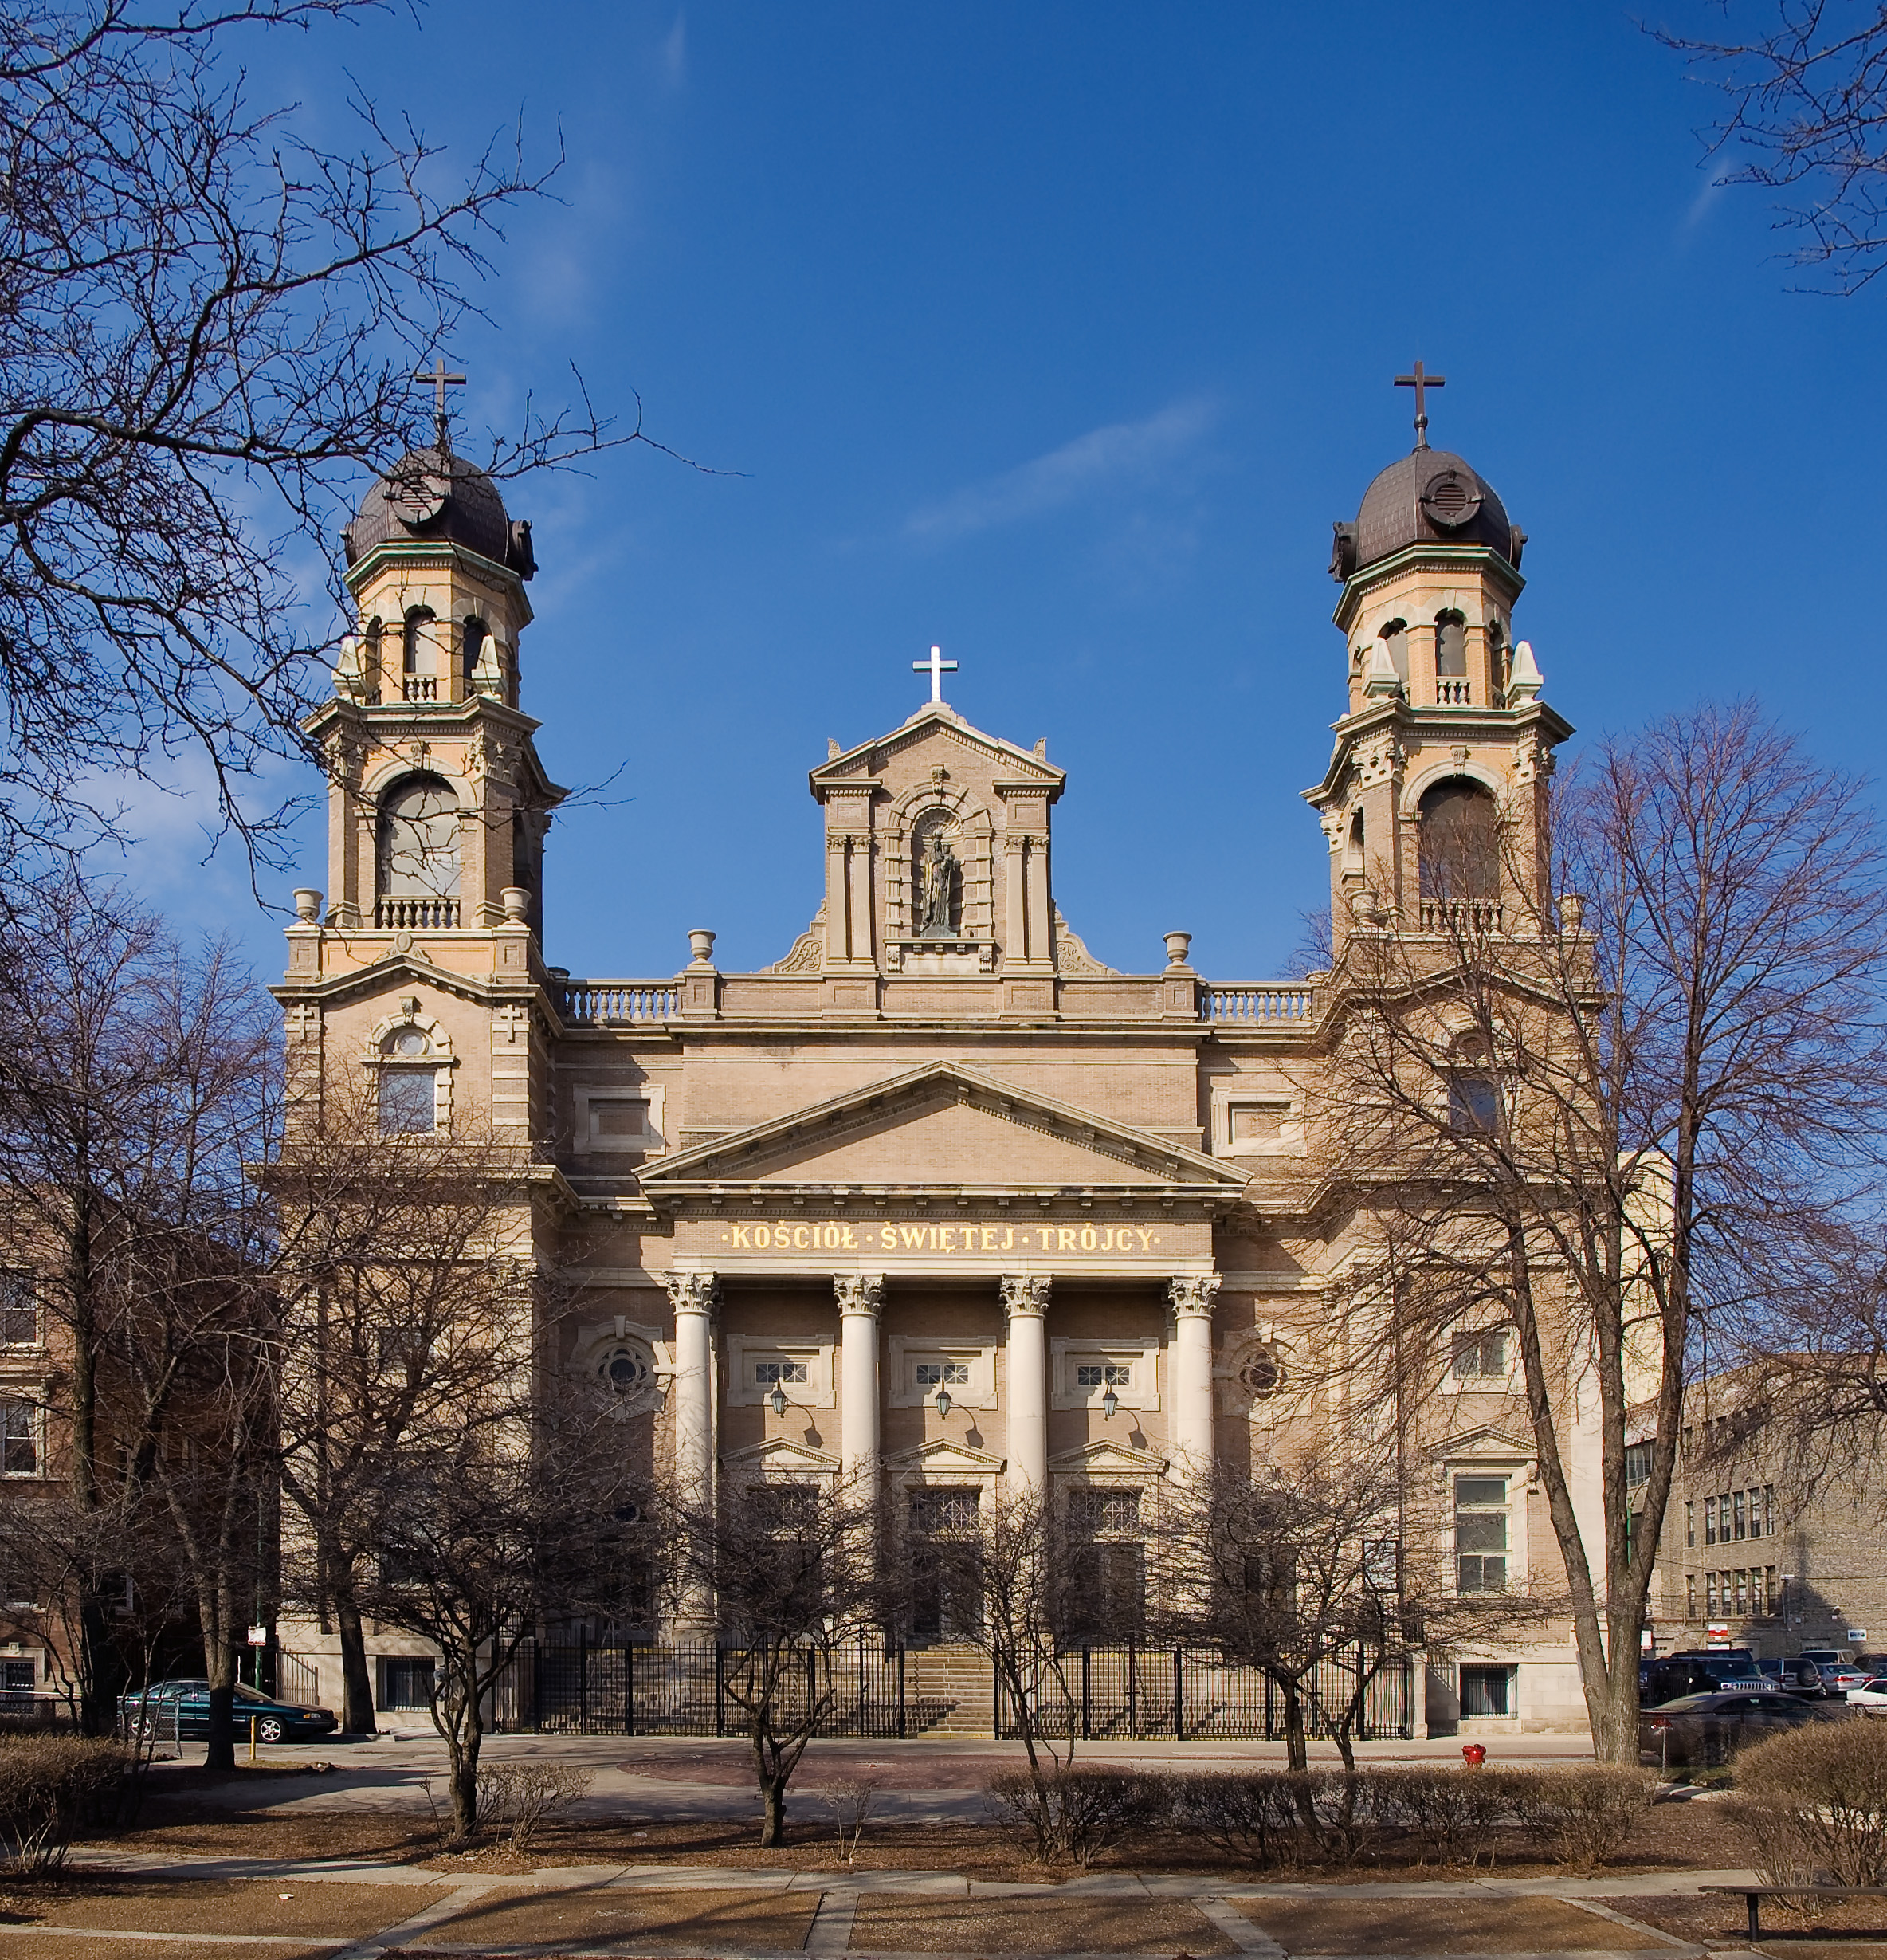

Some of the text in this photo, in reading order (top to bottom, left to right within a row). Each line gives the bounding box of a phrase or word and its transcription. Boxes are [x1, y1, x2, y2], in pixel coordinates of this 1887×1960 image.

[732, 1220, 1155, 1254] KOŚCIÓŁ ŚWIĘTEJ TRÓJCY
